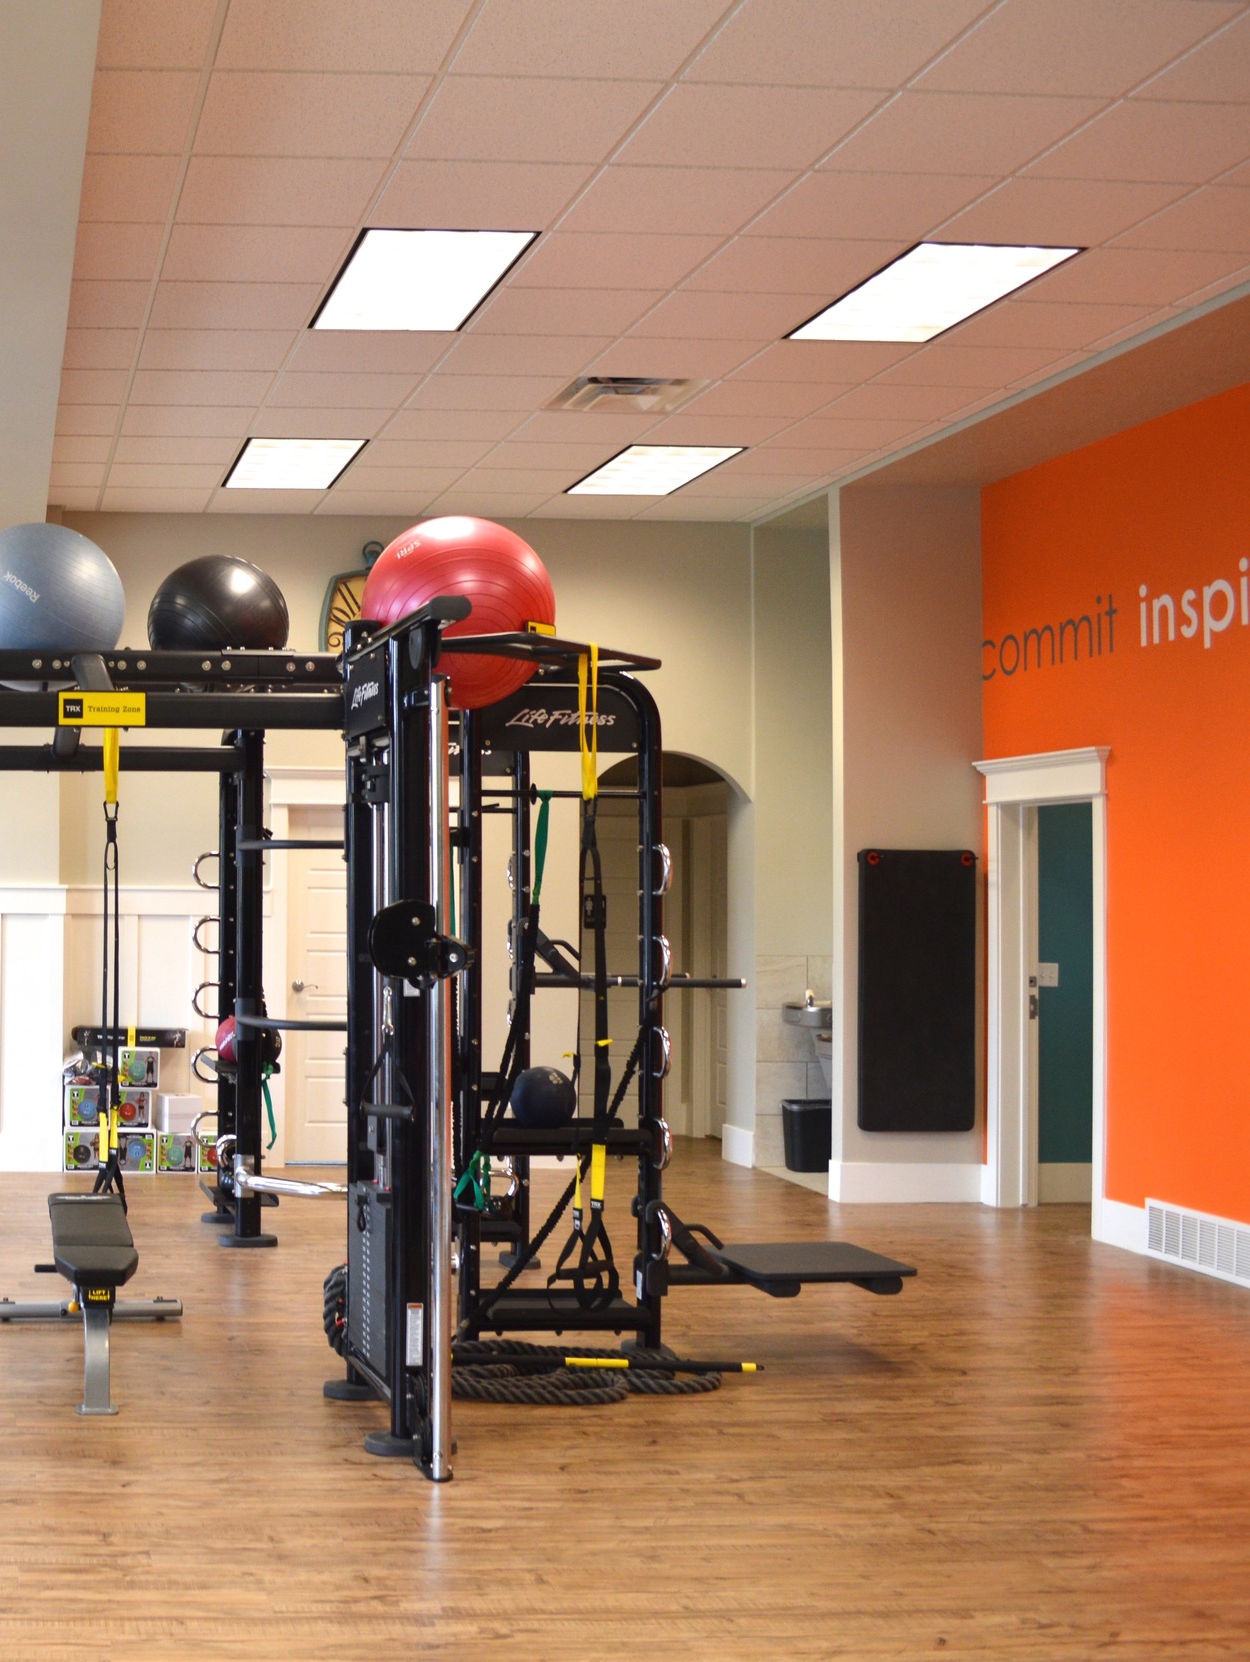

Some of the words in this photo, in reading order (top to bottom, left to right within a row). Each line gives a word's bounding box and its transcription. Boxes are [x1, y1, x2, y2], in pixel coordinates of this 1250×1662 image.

[3, 571, 40, 603] Reebok
[981, 593, 1118, 681] commit
[87, 705, 120, 713] Training
[122, 705, 141, 713] Zone
